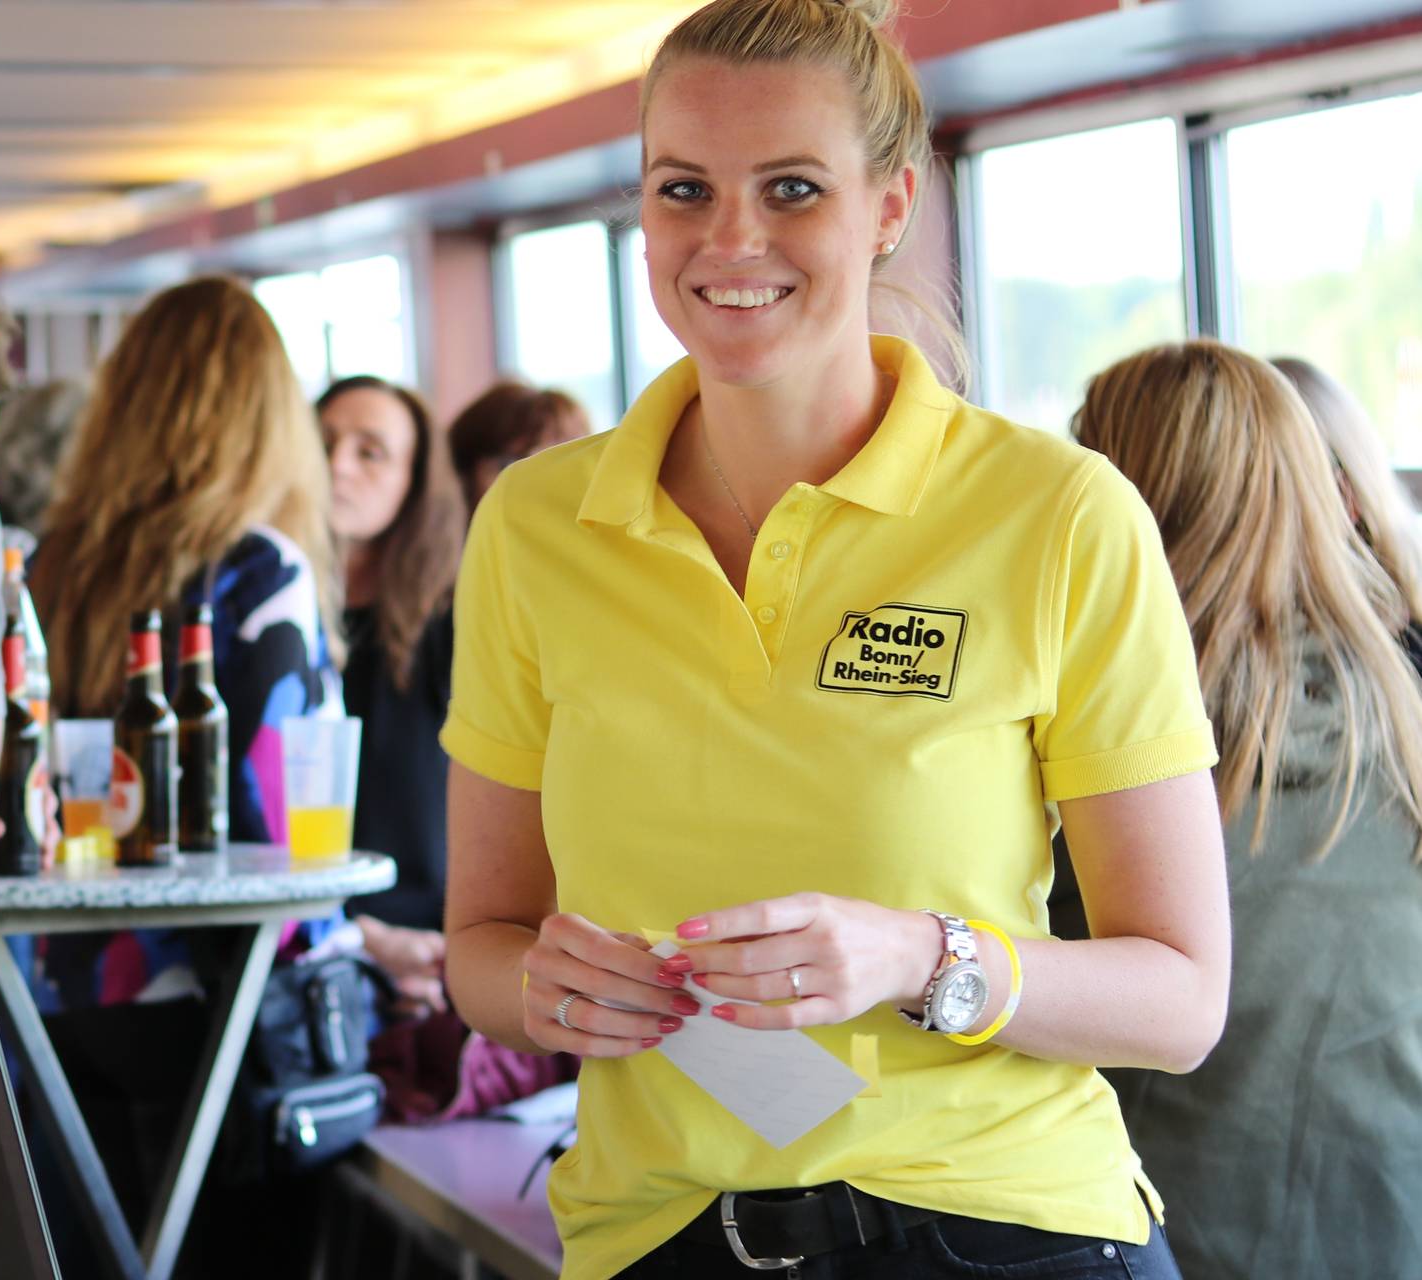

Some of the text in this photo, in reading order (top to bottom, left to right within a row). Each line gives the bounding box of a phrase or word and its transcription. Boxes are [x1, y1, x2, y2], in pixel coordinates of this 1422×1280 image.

[848, 615, 945, 649] Radio
[859, 644, 925, 668] Bonn/
[834, 661, 941, 689] Rhein-Sieg
